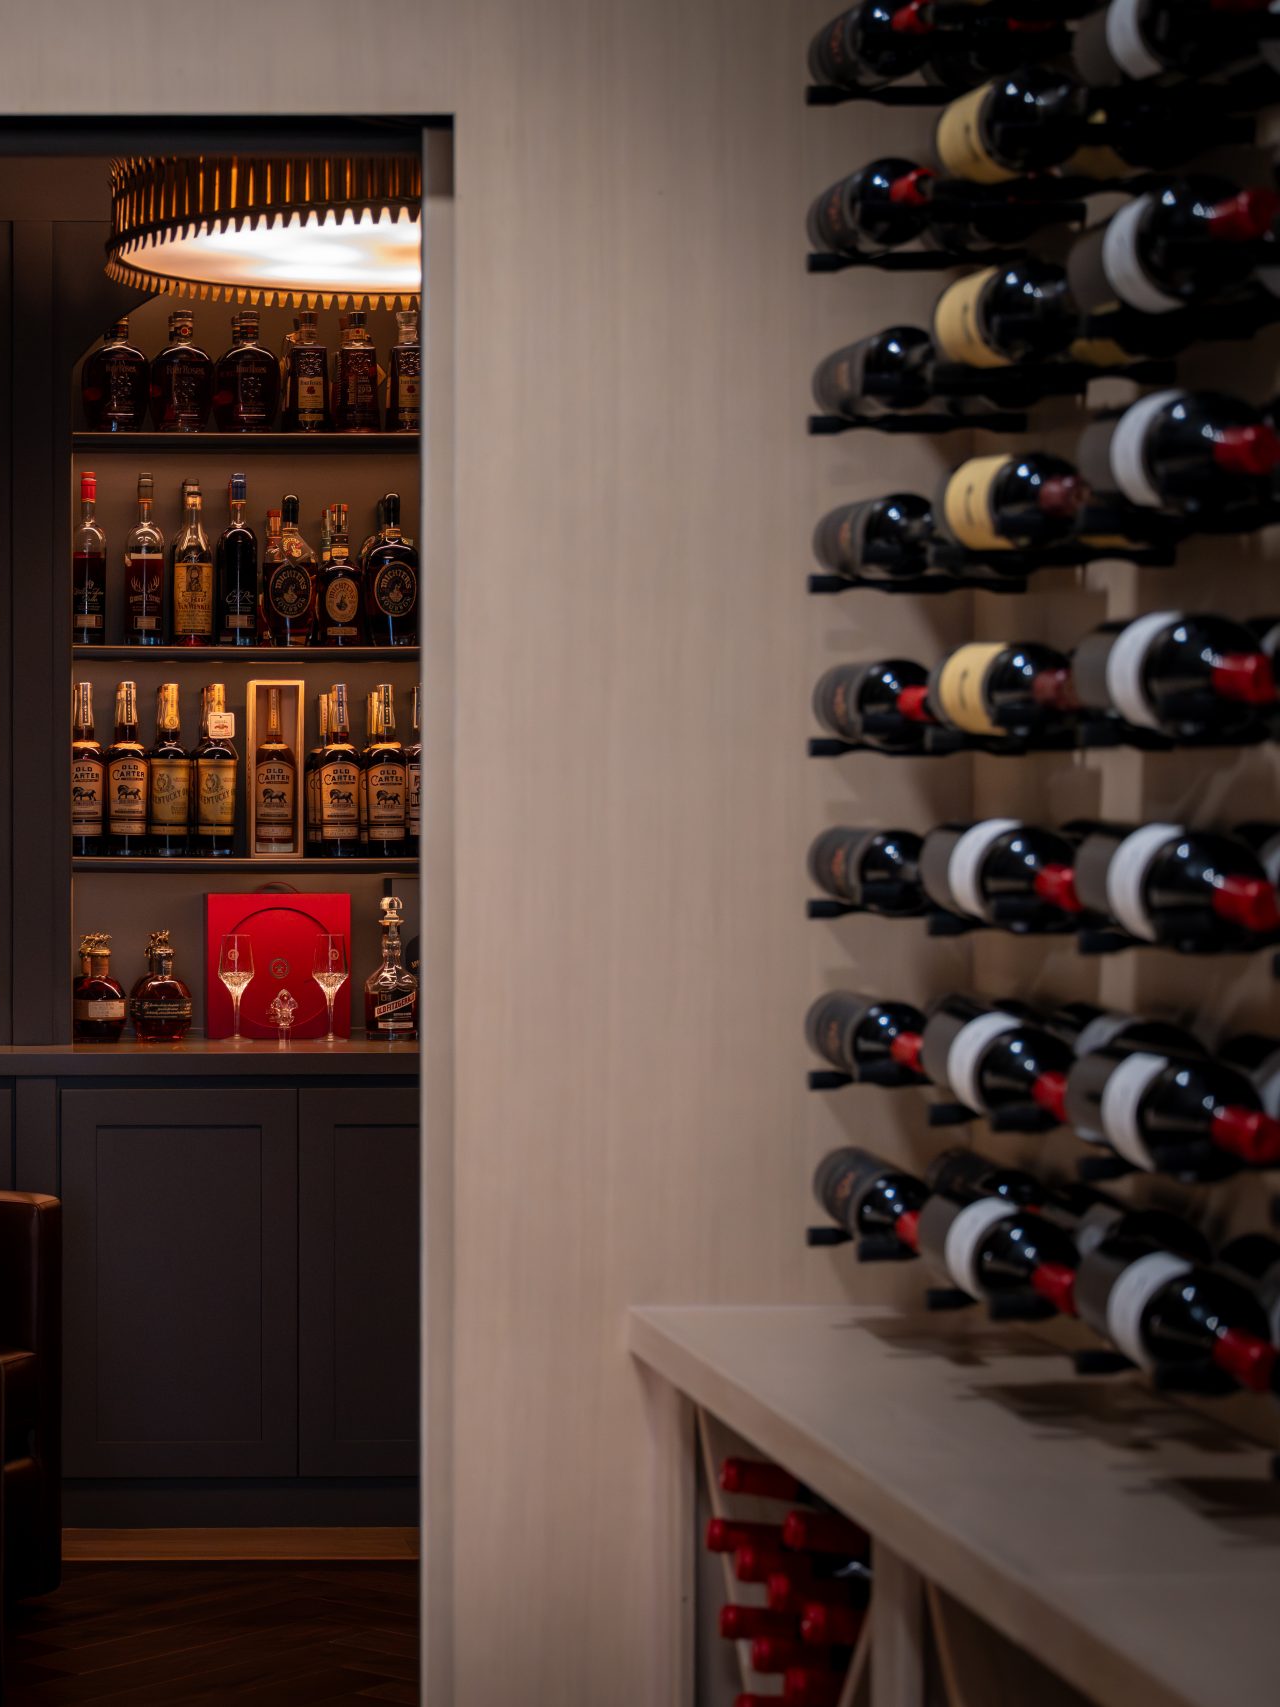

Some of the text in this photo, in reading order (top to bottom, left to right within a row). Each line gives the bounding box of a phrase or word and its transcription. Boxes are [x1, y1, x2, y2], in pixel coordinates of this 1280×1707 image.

[380, 569, 412, 589] MICHTER'S
[73, 772, 99, 780] ARTER
[112, 769, 145, 781] CARTER
[257, 773, 290, 784] CARTER
[323, 774, 356, 785] CARTER
[370, 775, 403, 786] CARTER
